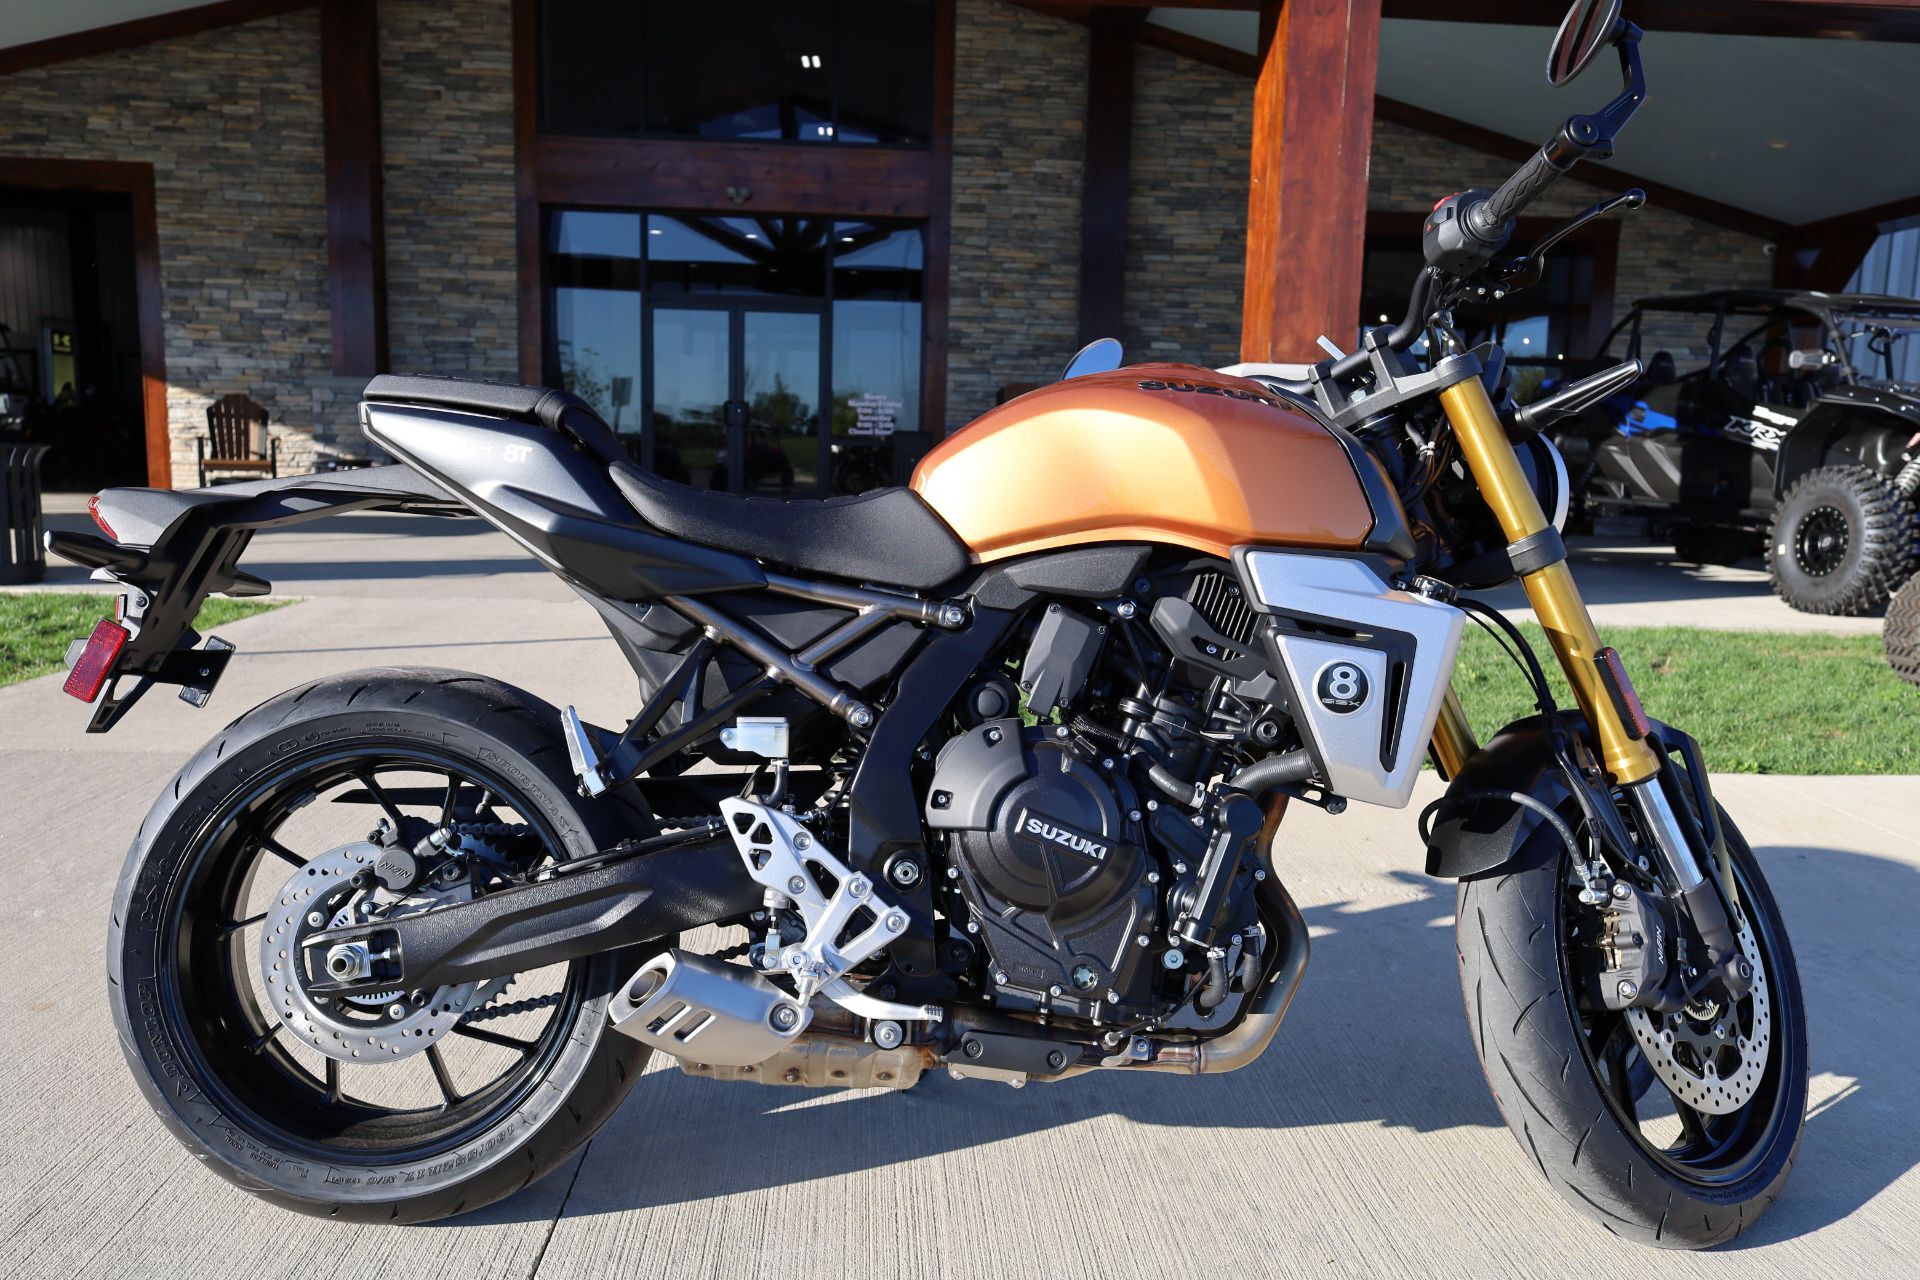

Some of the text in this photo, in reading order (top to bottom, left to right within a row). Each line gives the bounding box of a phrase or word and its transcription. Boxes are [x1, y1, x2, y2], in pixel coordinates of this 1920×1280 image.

[1329, 665, 1358, 700] 8
[1321, 697, 1361, 707] GSX
[1025, 818, 1107, 860] SUZUKI
